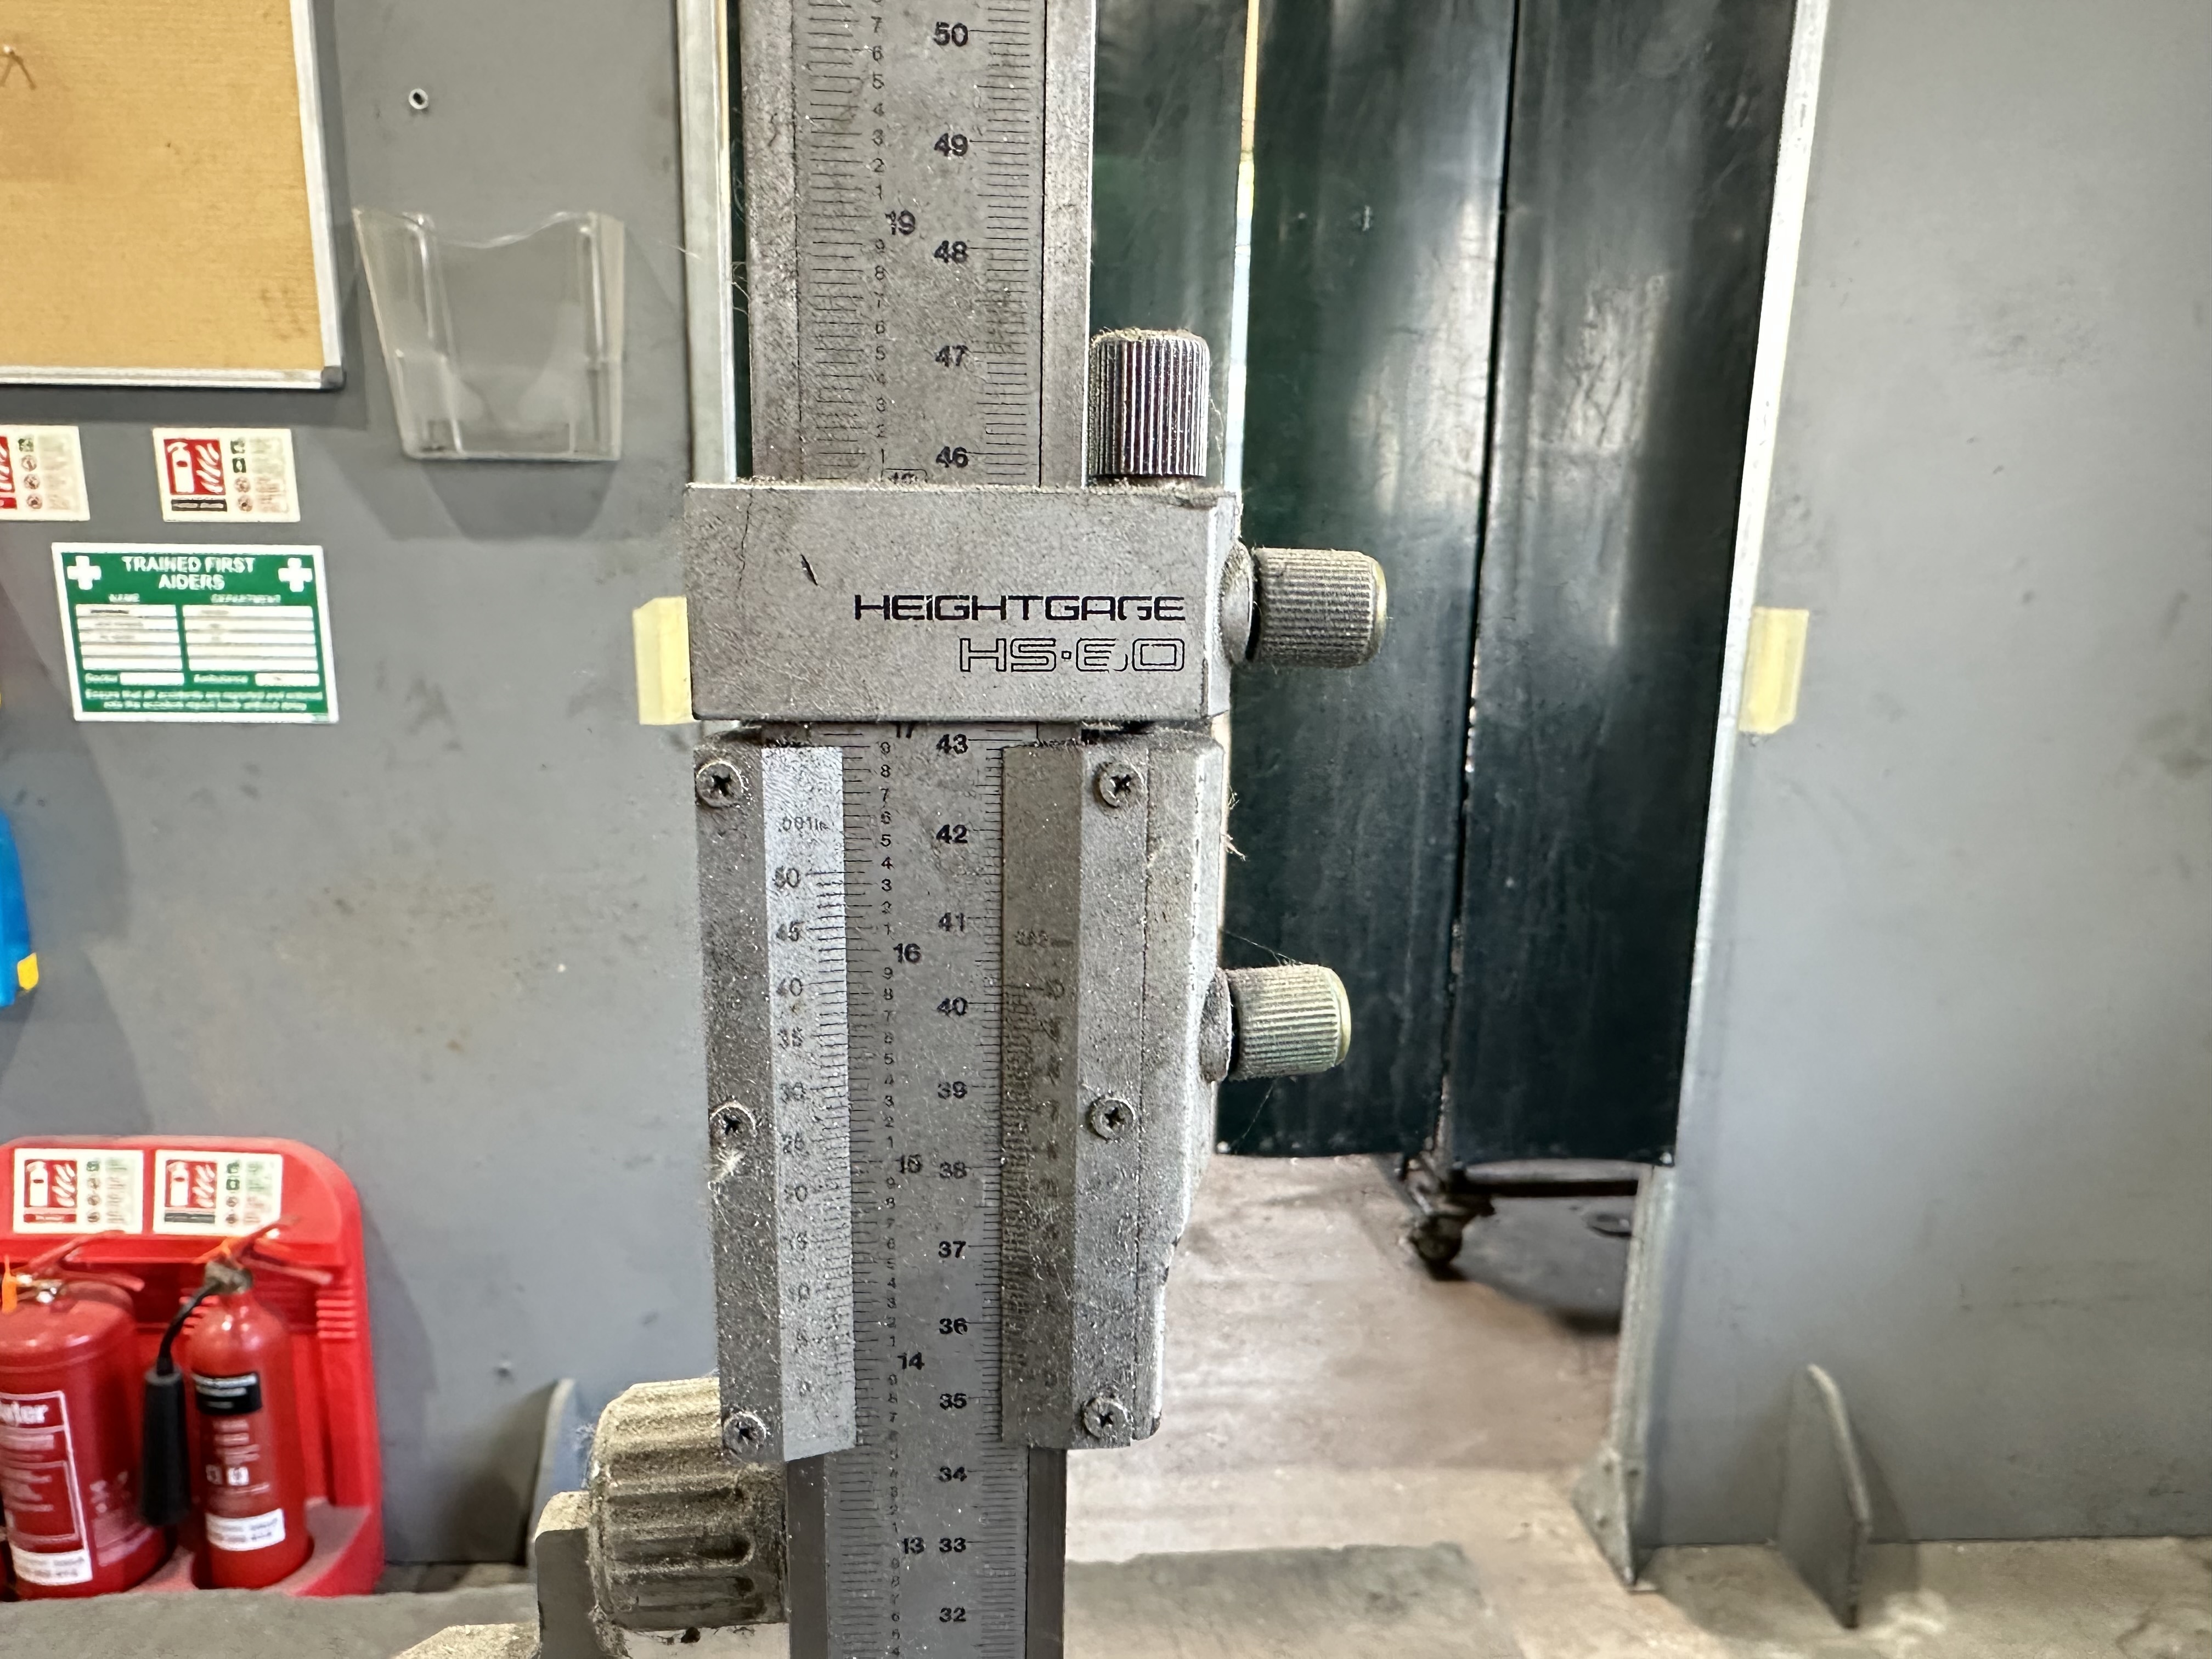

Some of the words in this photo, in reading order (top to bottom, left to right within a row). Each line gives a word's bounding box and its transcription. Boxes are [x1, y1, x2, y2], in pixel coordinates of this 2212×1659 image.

[871, 16, 882, 33] 7
[934, 22, 968, 47] 50
[873, 46, 884, 61] 6
[872, 72, 884, 89] 5
[934, 133, 968, 157] 49
[870, 158, 884, 172] 2
[876, 184, 882, 200] 1
[885, 210, 916, 235] 19
[934, 240, 969, 263] 48
[875, 266, 885, 280] 8
[876, 346, 885, 360] 5
[935, 345, 970, 367] 47
[936, 446, 969, 467] 46
[121, 556, 201, 573] TRAINED
[205, 556, 256, 573] FIRST
[159, 573, 225, 591] AIDERS
[854, 595, 1186, 621] HEIGHTGAGE
[936, 734, 968, 754] 43
[881, 764, 891, 777] 8
[880, 788, 889, 802] 7
[881, 811, 891, 824] 6
[881, 834, 891, 847] 5
[936, 824, 968, 844] 42
[881, 856, 895, 870] 4
[882, 879, 893, 891] 3
[938, 912, 965, 932] 41
[893, 943, 922, 964] 16
[883, 967, 893, 980] 9
[936, 997, 968, 1017] 40
[884, 1053, 894, 1065] 5
[938, 1081, 968, 1099] 39
[888, 1136, 893, 1148] 1
[939, 1161, 967, 1179] 38
[938, 1240, 967, 1258] 37
[887, 1277, 896, 1289] 4
[939, 1318, 968, 1335] 36
[889, 1336, 895, 1347] 1
[898, 1351, 925, 1370] 14
[940, 1393, 967, 1410] 35
[939, 1466, 968, 1482] 34
[901, 1537, 925, 1554] 13
[939, 1537, 967, 1553] 33
[939, 1606, 967, 1622] 32
